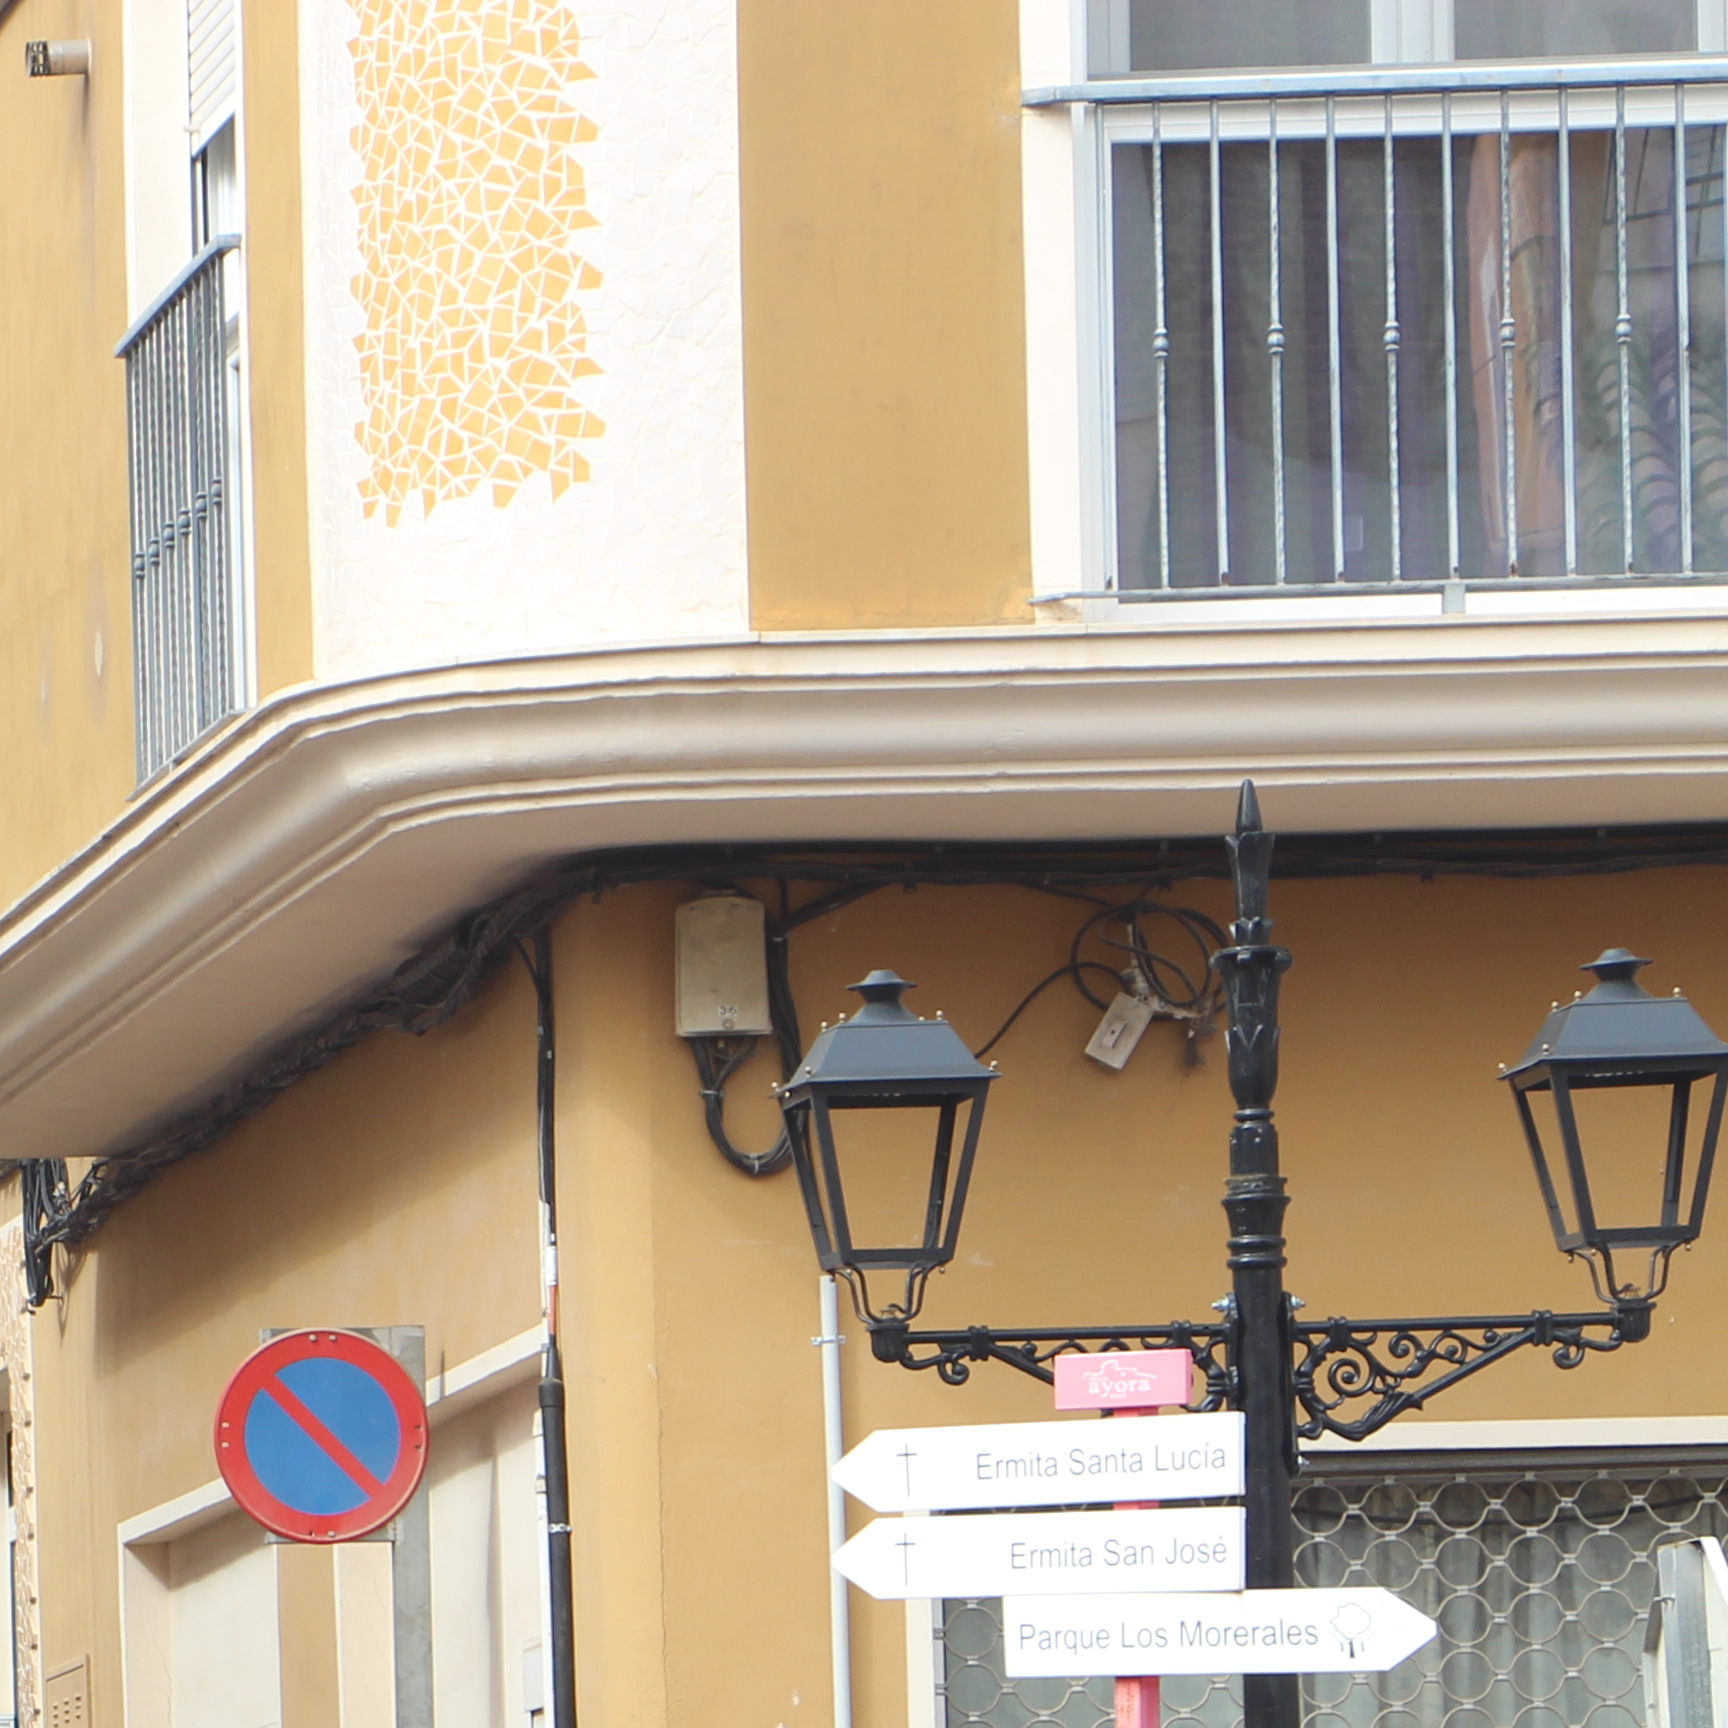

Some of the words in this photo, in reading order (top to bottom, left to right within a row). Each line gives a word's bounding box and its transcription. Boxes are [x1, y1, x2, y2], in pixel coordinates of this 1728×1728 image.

[720, 1005, 737, 1015] 36
[1088, 1378, 1151, 1398] ayora
[976, 1451, 1059, 1480] Ermita
[1069, 1447, 1144, 1476] Santa
[1153, 1442, 1226, 1472] Lucía
[1010, 1541, 1093, 1570] Ermita
[1103, 1538, 1155, 1567] San
[1164, 1535, 1228, 1566] José
[1019, 1623, 1111, 1656] Parque
[1120, 1621, 1169, 1649] Los
[1179, 1618, 1319, 1648] Morerales
